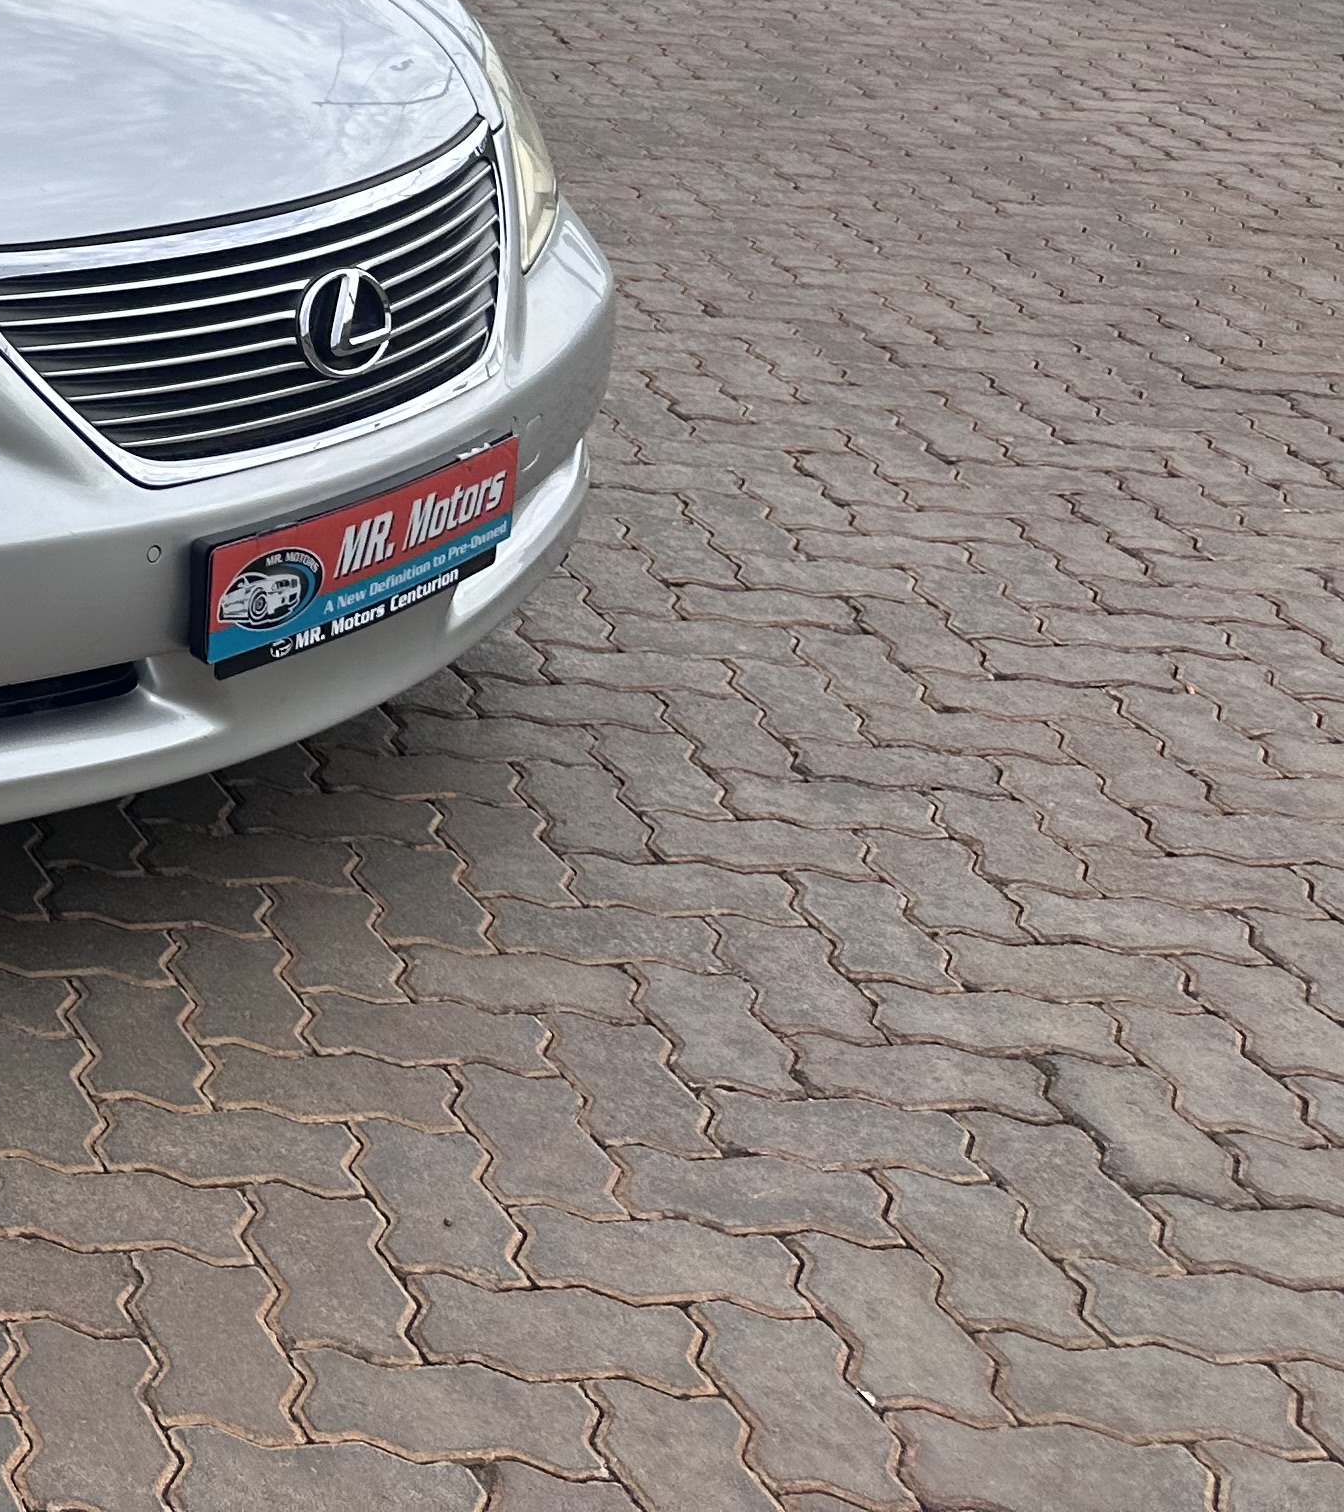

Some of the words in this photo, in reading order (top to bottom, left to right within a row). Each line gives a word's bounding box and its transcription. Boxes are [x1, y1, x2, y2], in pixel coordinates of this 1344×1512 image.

[285, 551, 320, 574] MOTORS
[323, 599, 334, 616] A
[336, 587, 367, 610] New
[369, 562, 431, 597] Definition
[433, 552, 446, 568] to
[448, 520, 508, 561] Pre-Owned
[332, 510, 395, 579] MR.
[402, 469, 507, 552] Motors
[295, 625, 326, 650] MR.
[331, 603, 386, 637] Motors
[390, 568, 459, 612] Centurion
